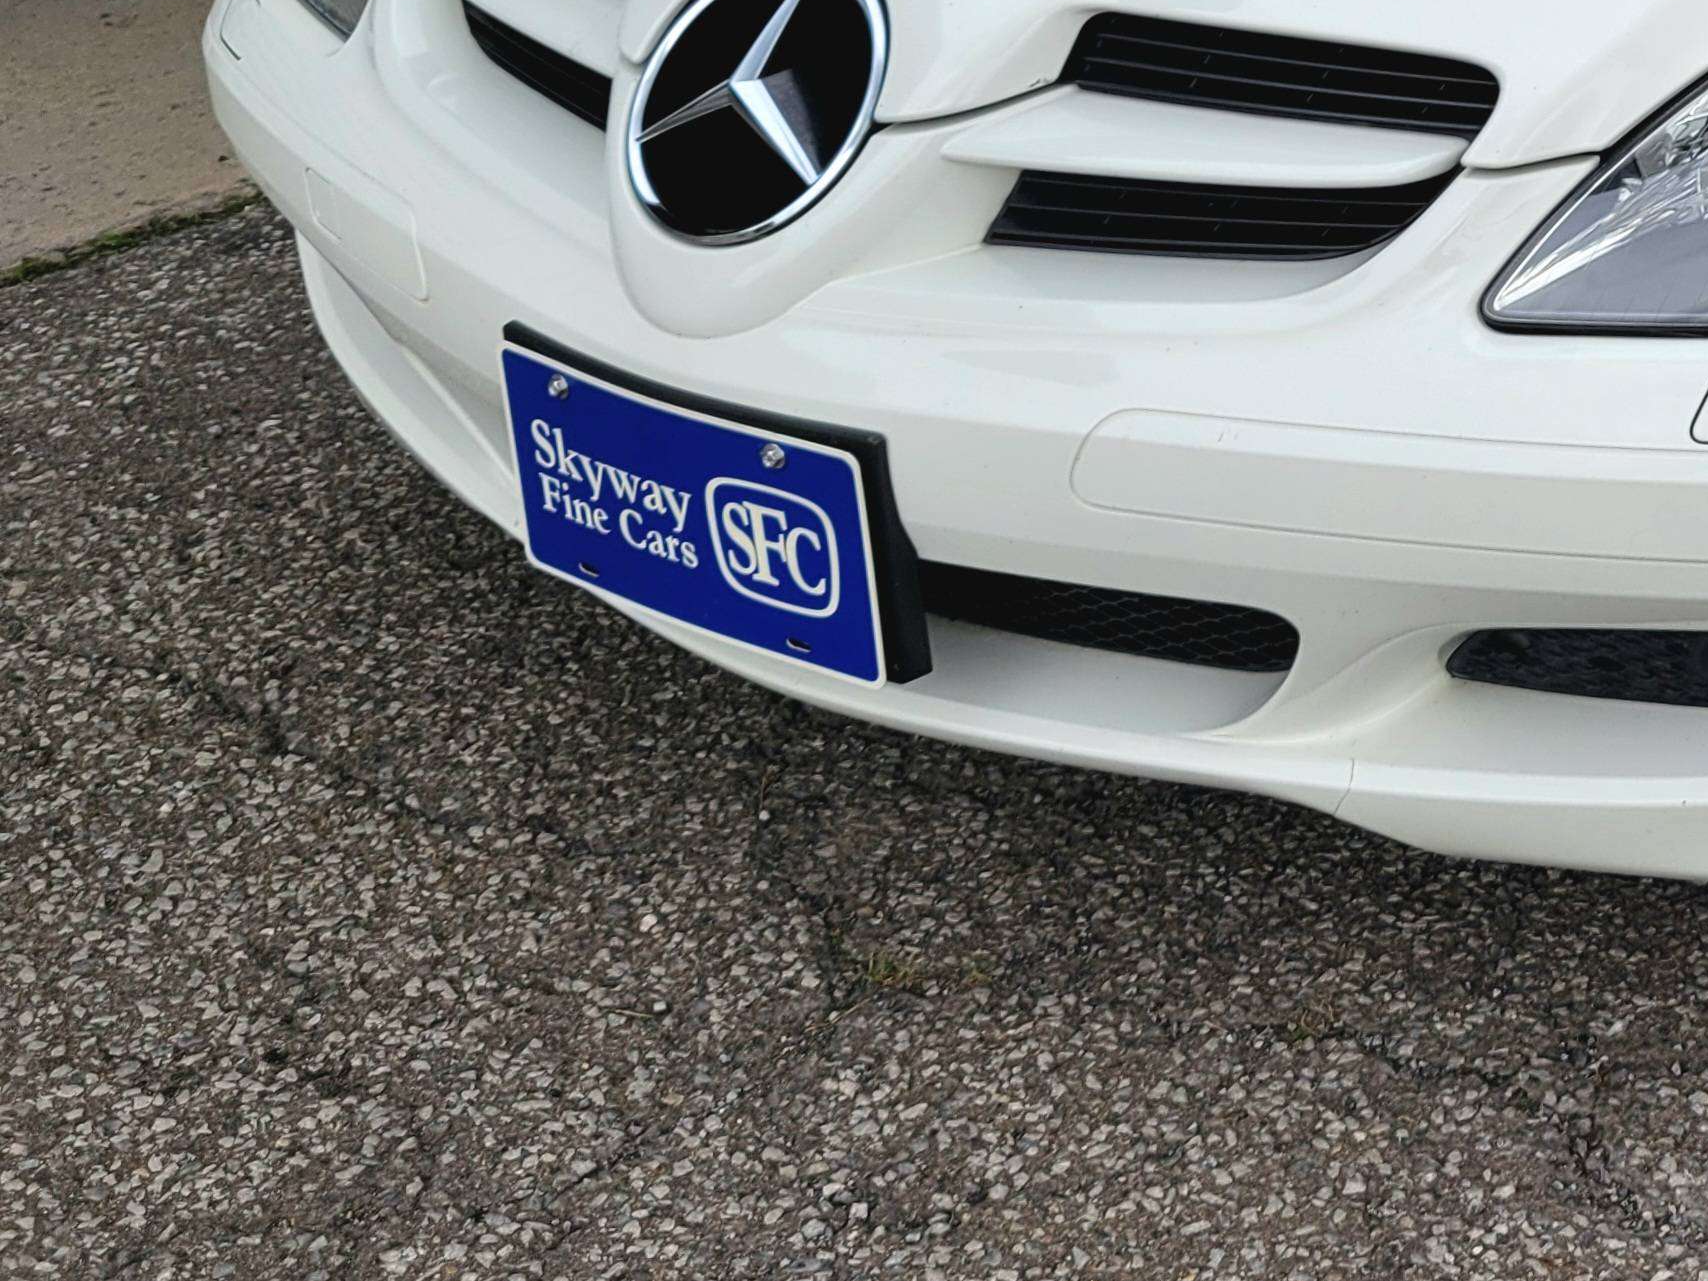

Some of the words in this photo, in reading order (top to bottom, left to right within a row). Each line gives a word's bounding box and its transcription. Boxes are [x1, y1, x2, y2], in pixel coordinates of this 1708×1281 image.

[530, 418, 693, 533] Skyway
[537, 471, 612, 536] Fine
[618, 507, 700, 570] Cars
[721, 500, 827, 597] SFC
